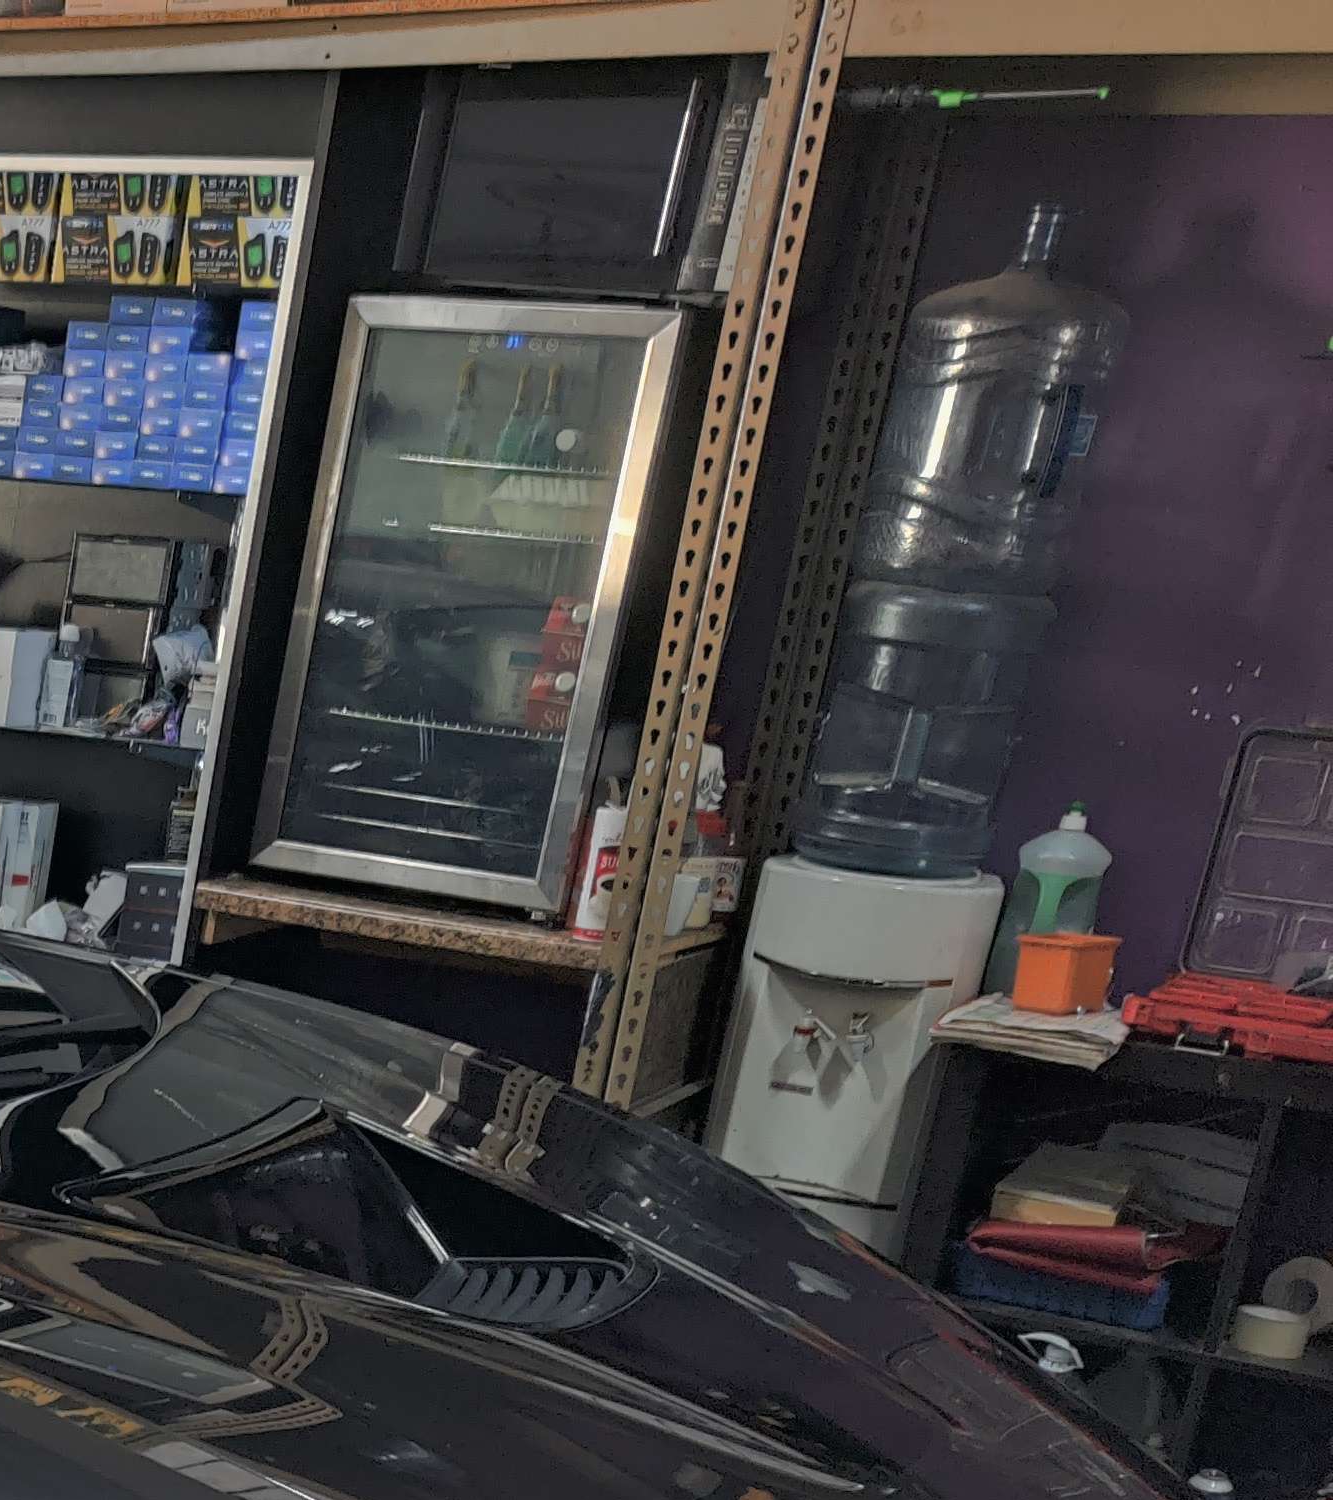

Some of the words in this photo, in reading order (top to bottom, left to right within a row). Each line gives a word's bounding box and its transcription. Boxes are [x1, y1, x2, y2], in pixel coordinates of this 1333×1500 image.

[72, 179, 118, 190] ASTRA
[200, 176, 248, 188] ASTRA
[64, 246, 108, 256] ASTRA
[190, 248, 238, 259] ASTRA
